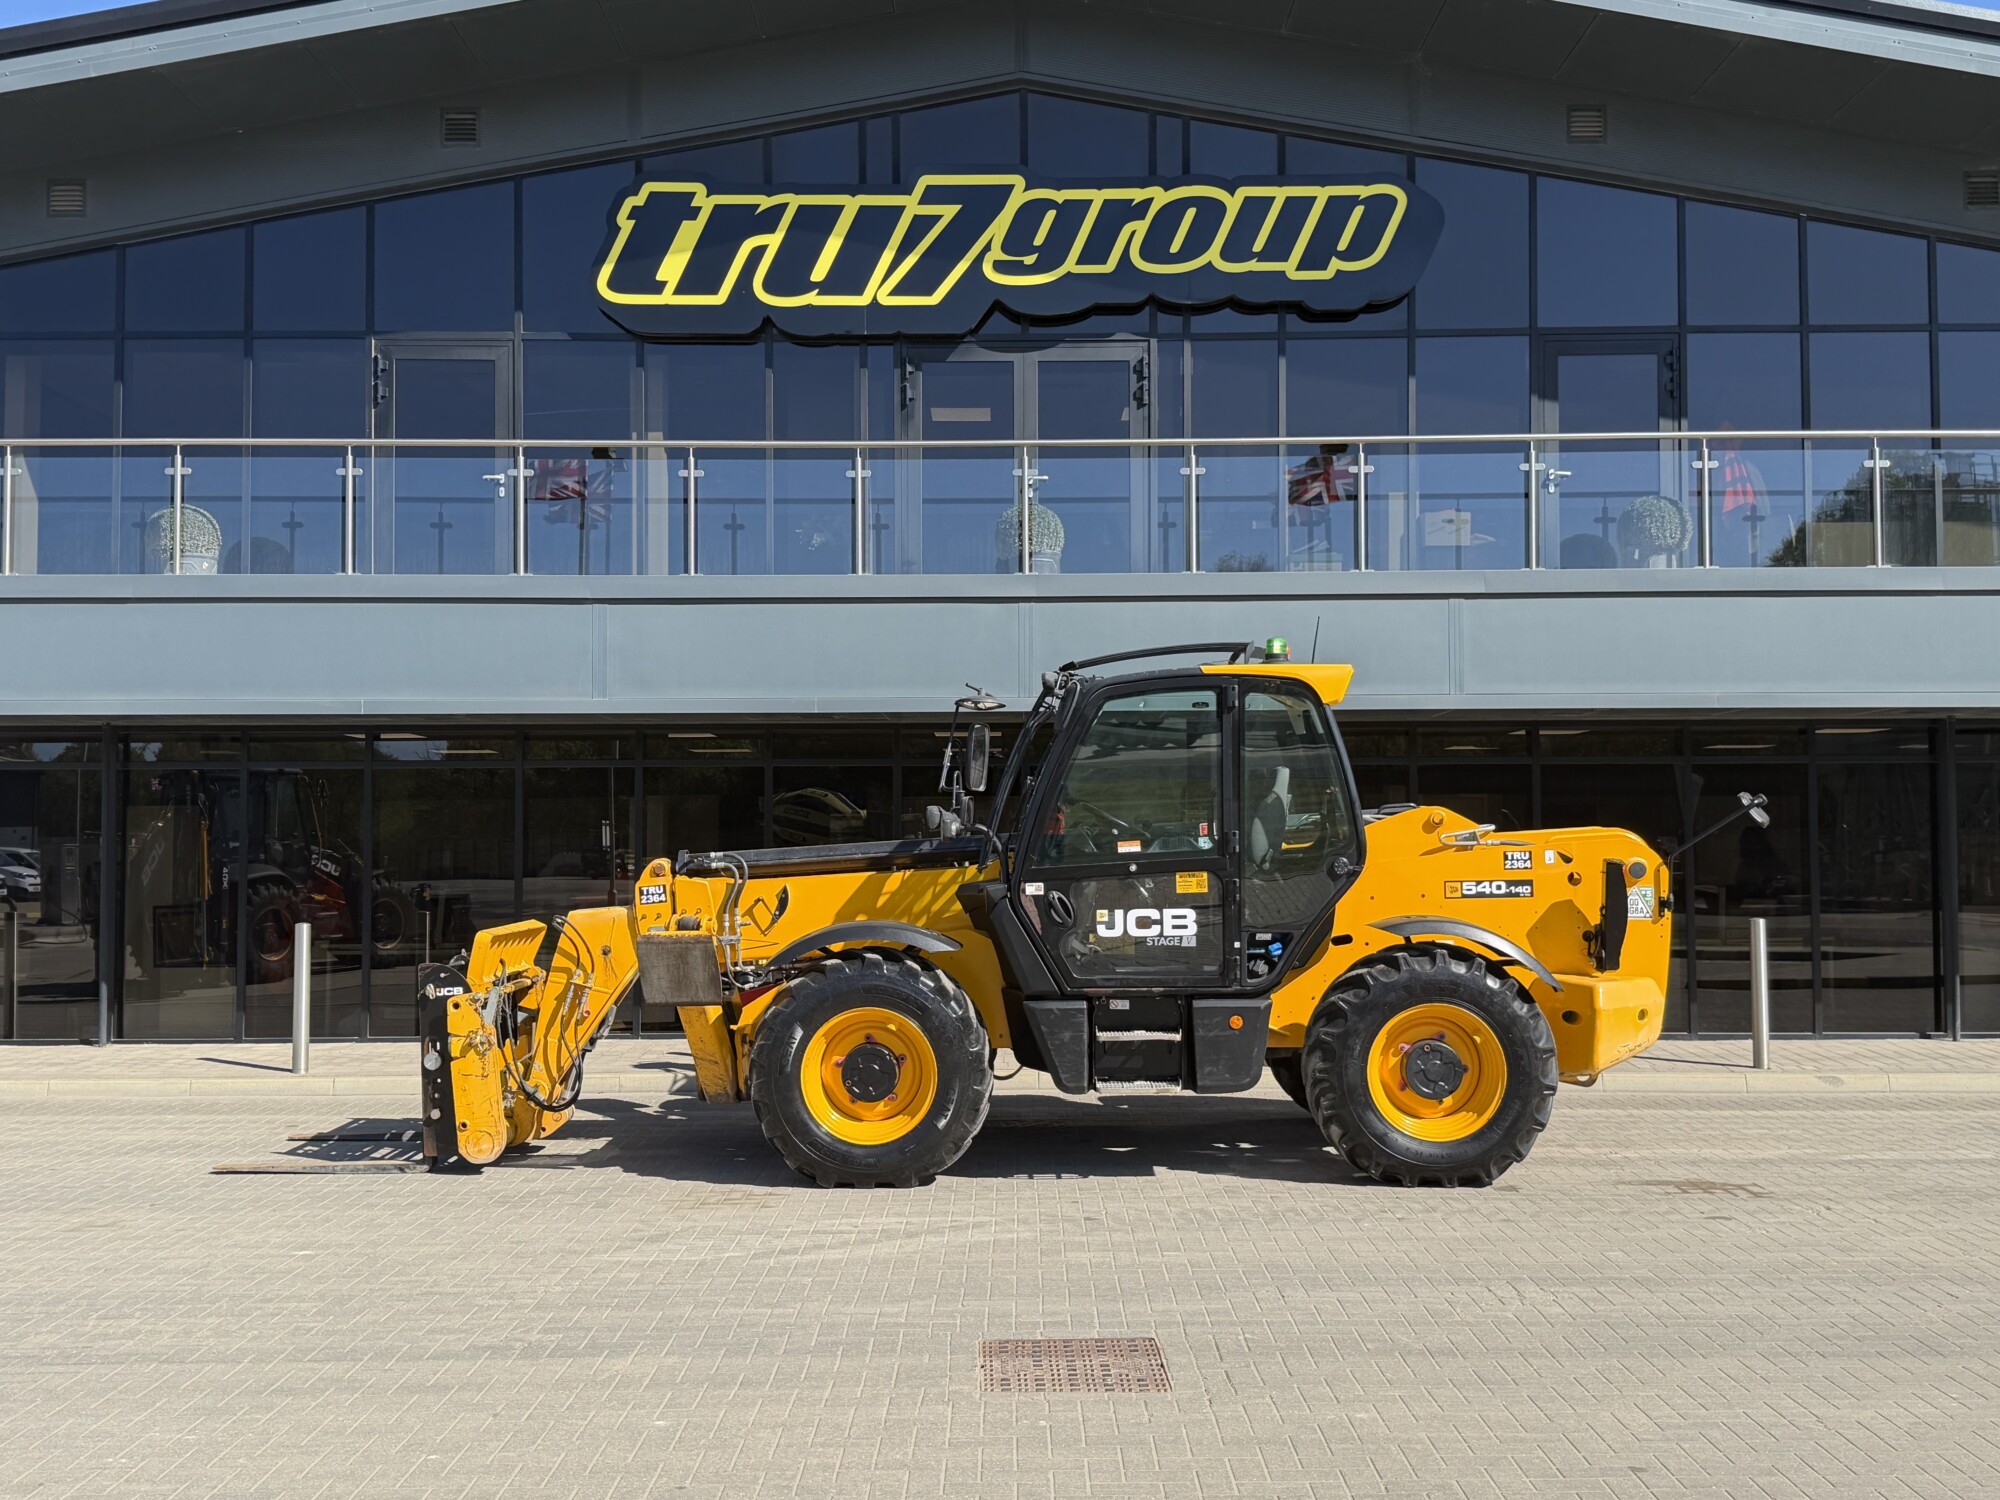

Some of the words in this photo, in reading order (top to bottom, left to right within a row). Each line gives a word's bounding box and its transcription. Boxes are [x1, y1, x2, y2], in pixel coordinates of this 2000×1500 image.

[1506, 852, 1529, 860] TRU
[1505, 860, 1531, 868] 2364
[641, 885, 664, 895] TRU
[641, 894, 666, 904] 2364
[1096, 909, 1197, 937] JCB
[1146, 937, 1180, 946] STAGE
[436, 987, 463, 996] JCB
